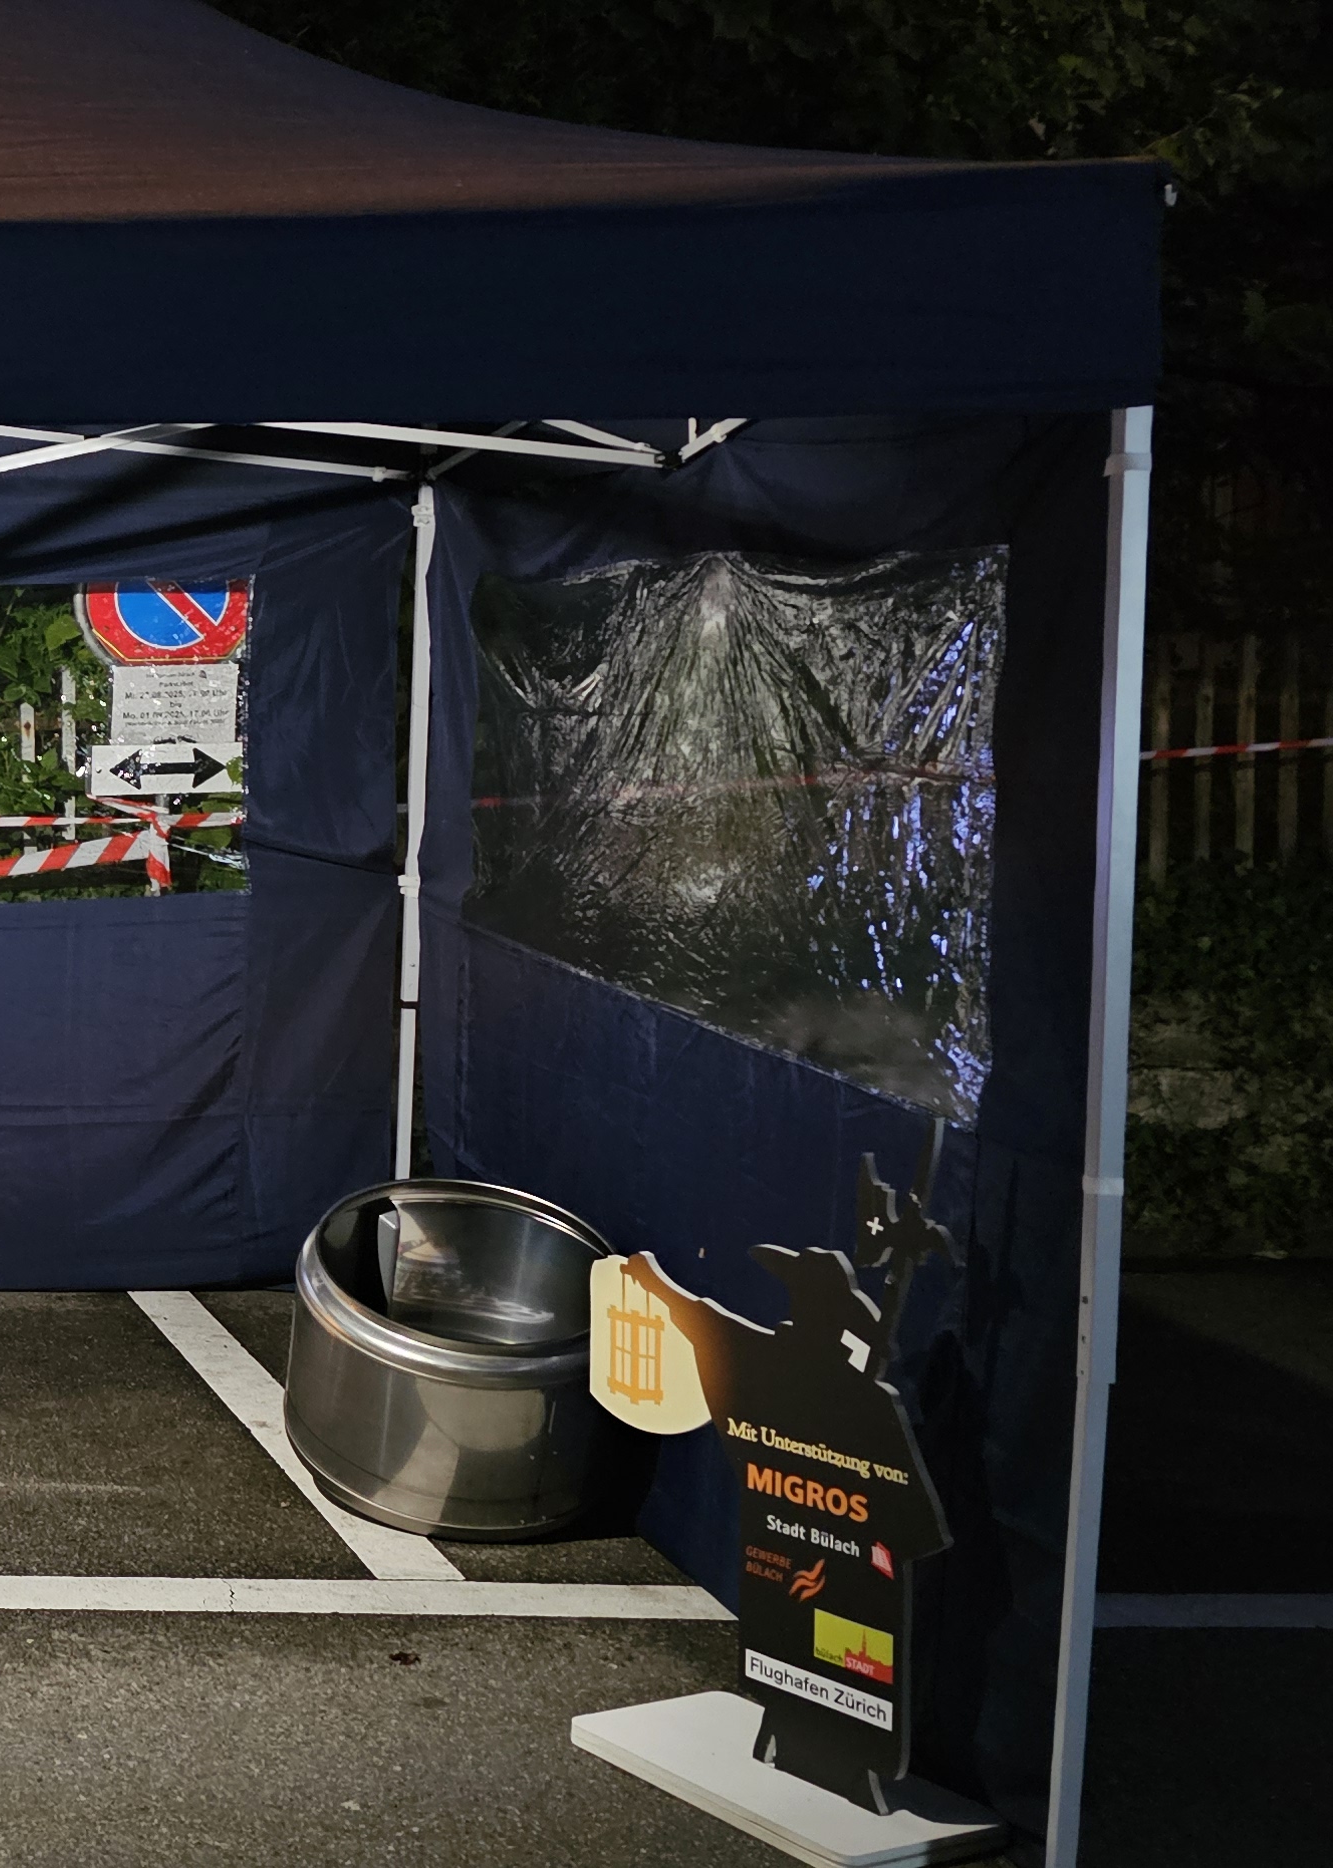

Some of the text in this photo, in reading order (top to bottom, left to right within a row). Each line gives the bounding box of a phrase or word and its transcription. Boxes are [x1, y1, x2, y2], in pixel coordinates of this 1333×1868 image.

[727, 1417, 909, 1485] Mit Unterstützung von:
[747, 1462, 869, 1523] MIGROS
[766, 1515, 860, 1557] Stadt Bülach
[745, 1545, 792, 1570] GEWERBE
[745, 1561, 784, 1583] BÜLACH
[815, 1646, 875, 1675] bülach STADT
[750, 1656, 886, 1722] Flughafen Zürich
